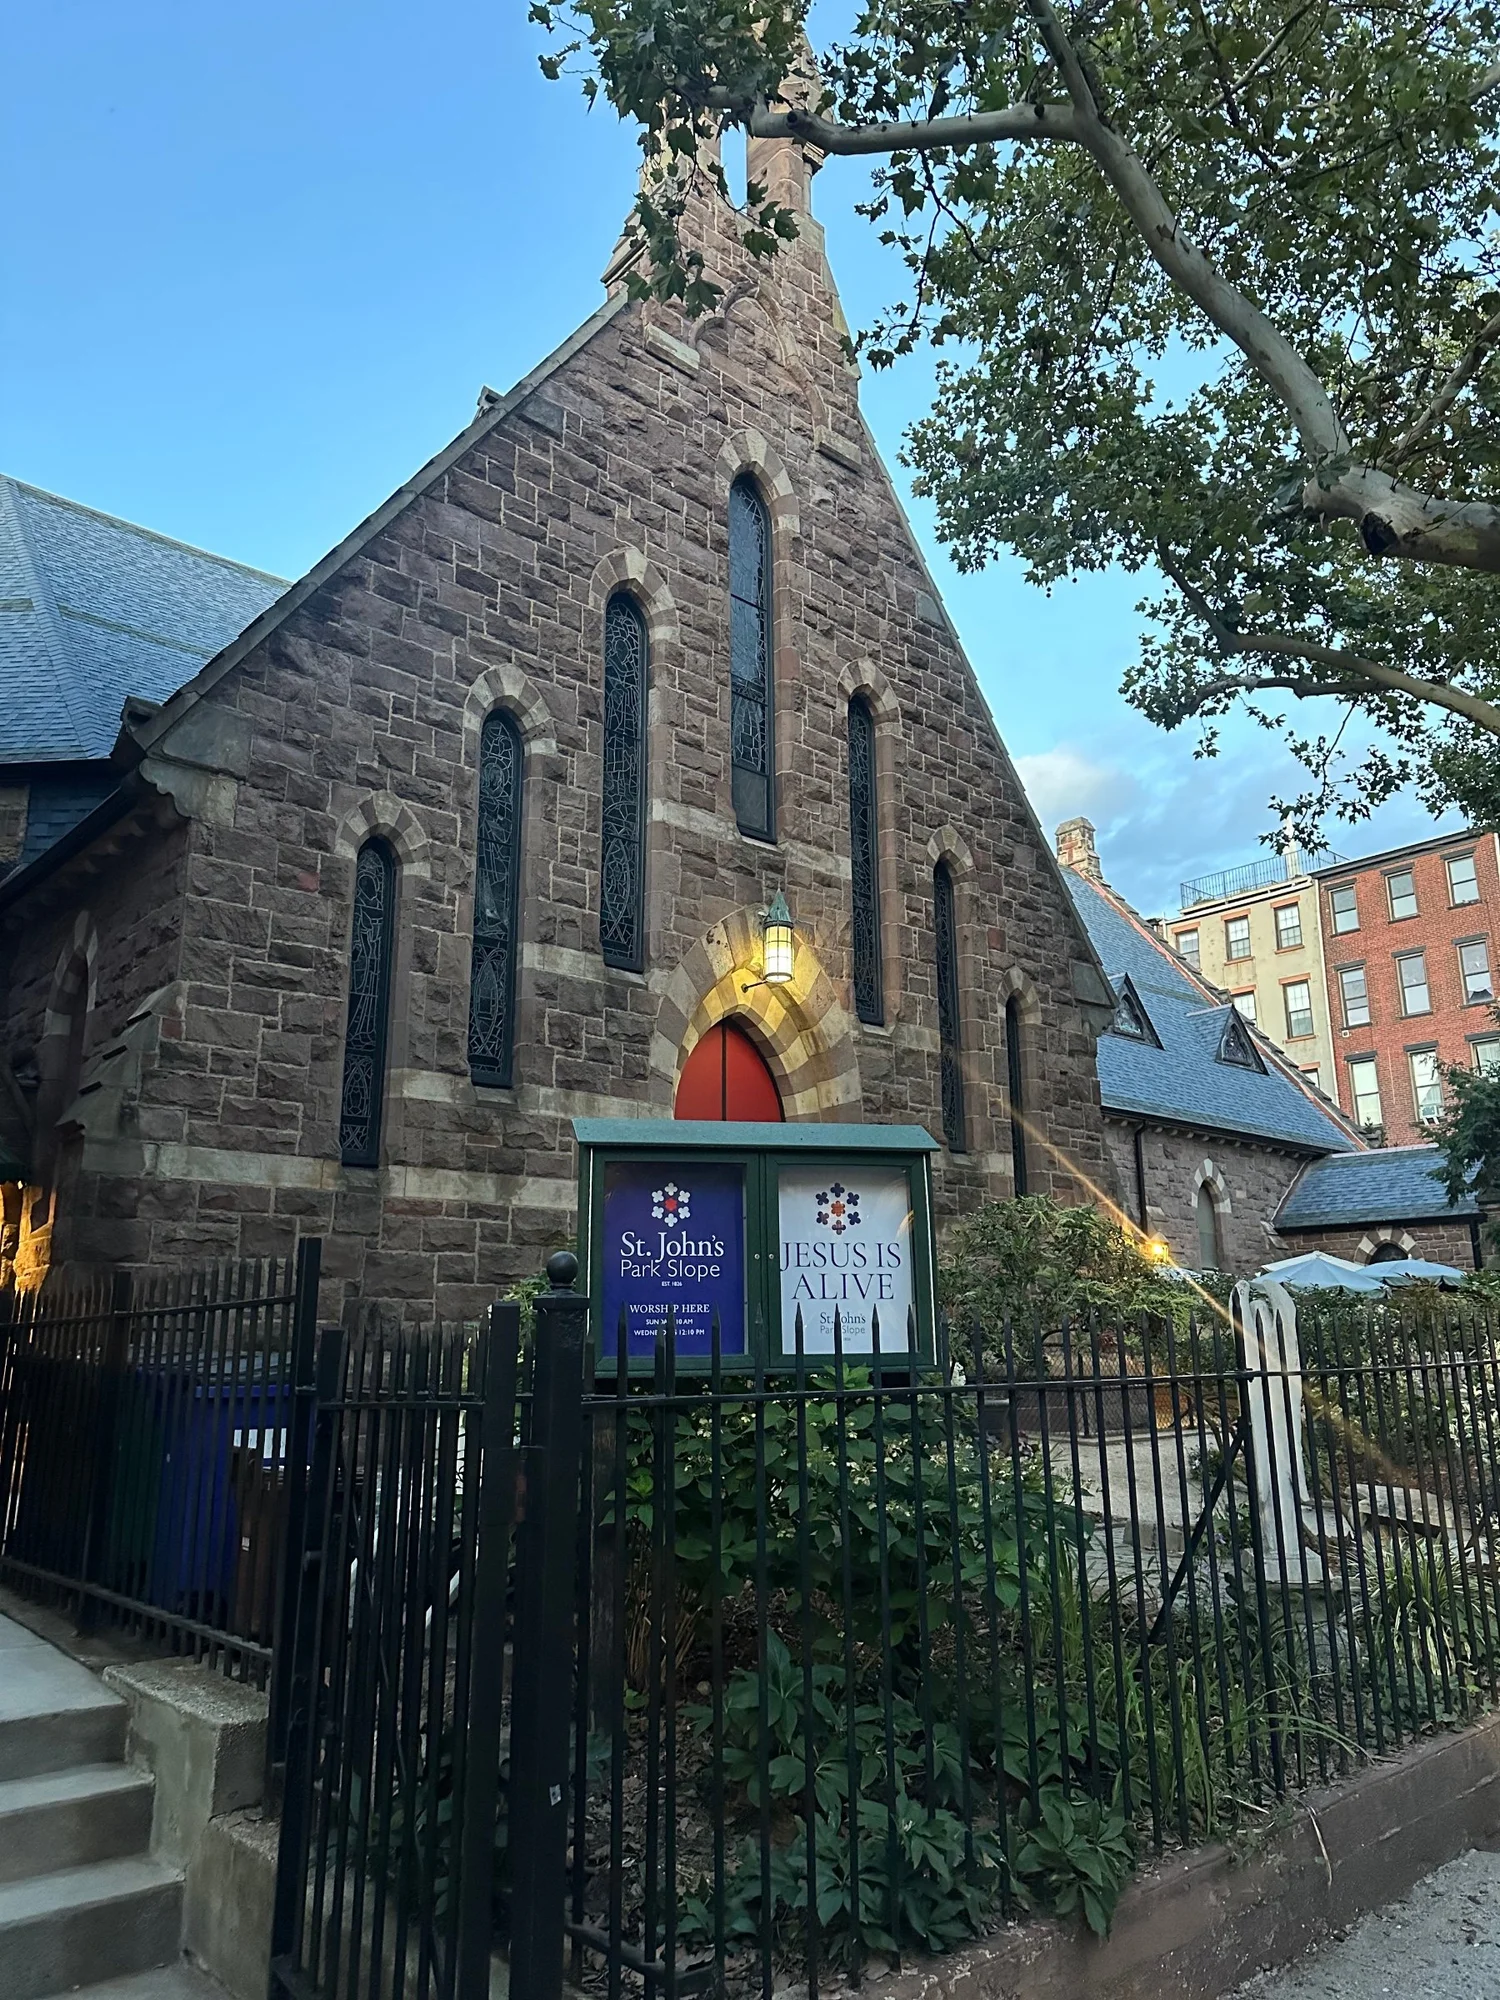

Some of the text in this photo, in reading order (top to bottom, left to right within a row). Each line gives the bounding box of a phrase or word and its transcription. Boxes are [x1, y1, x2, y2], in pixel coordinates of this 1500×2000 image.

[620, 1231, 724, 1263] St. John's
[780, 1241, 901, 1271] JESUS IS
[620, 1259, 721, 1282] Park Slope
[791, 1273, 894, 1300] ALIVE
[629, 1304, 710, 1313] WORSHP HERE
[820, 1311, 866, 1325] St. ohn's
[820, 1325, 866, 1336] Par Slope
